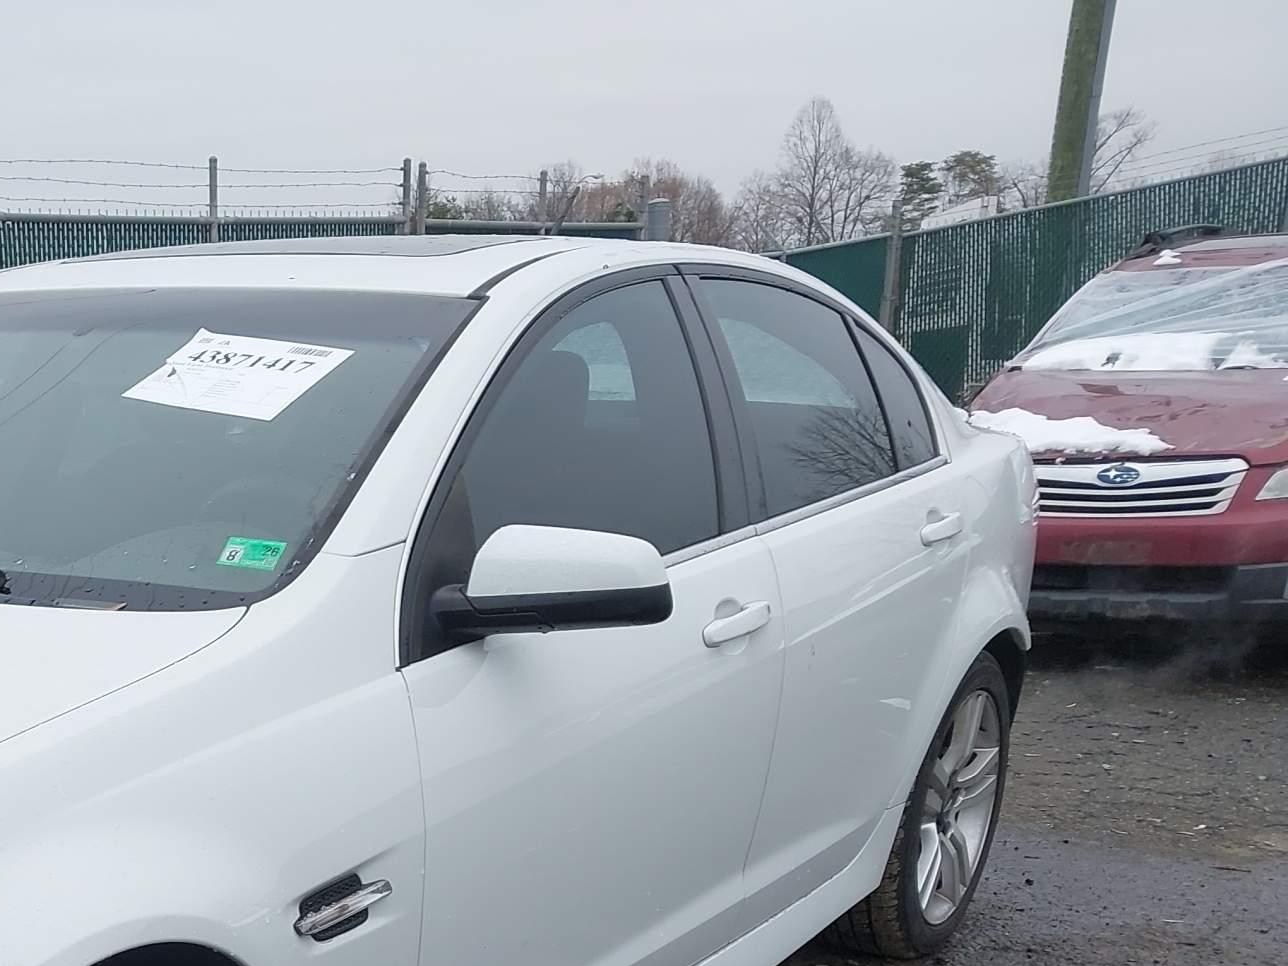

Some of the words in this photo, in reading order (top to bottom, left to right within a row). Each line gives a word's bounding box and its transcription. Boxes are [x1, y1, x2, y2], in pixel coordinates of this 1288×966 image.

[188, 349, 316, 374] 43871417
[226, 549, 241, 561] 8
[262, 544, 280, 557] 26
